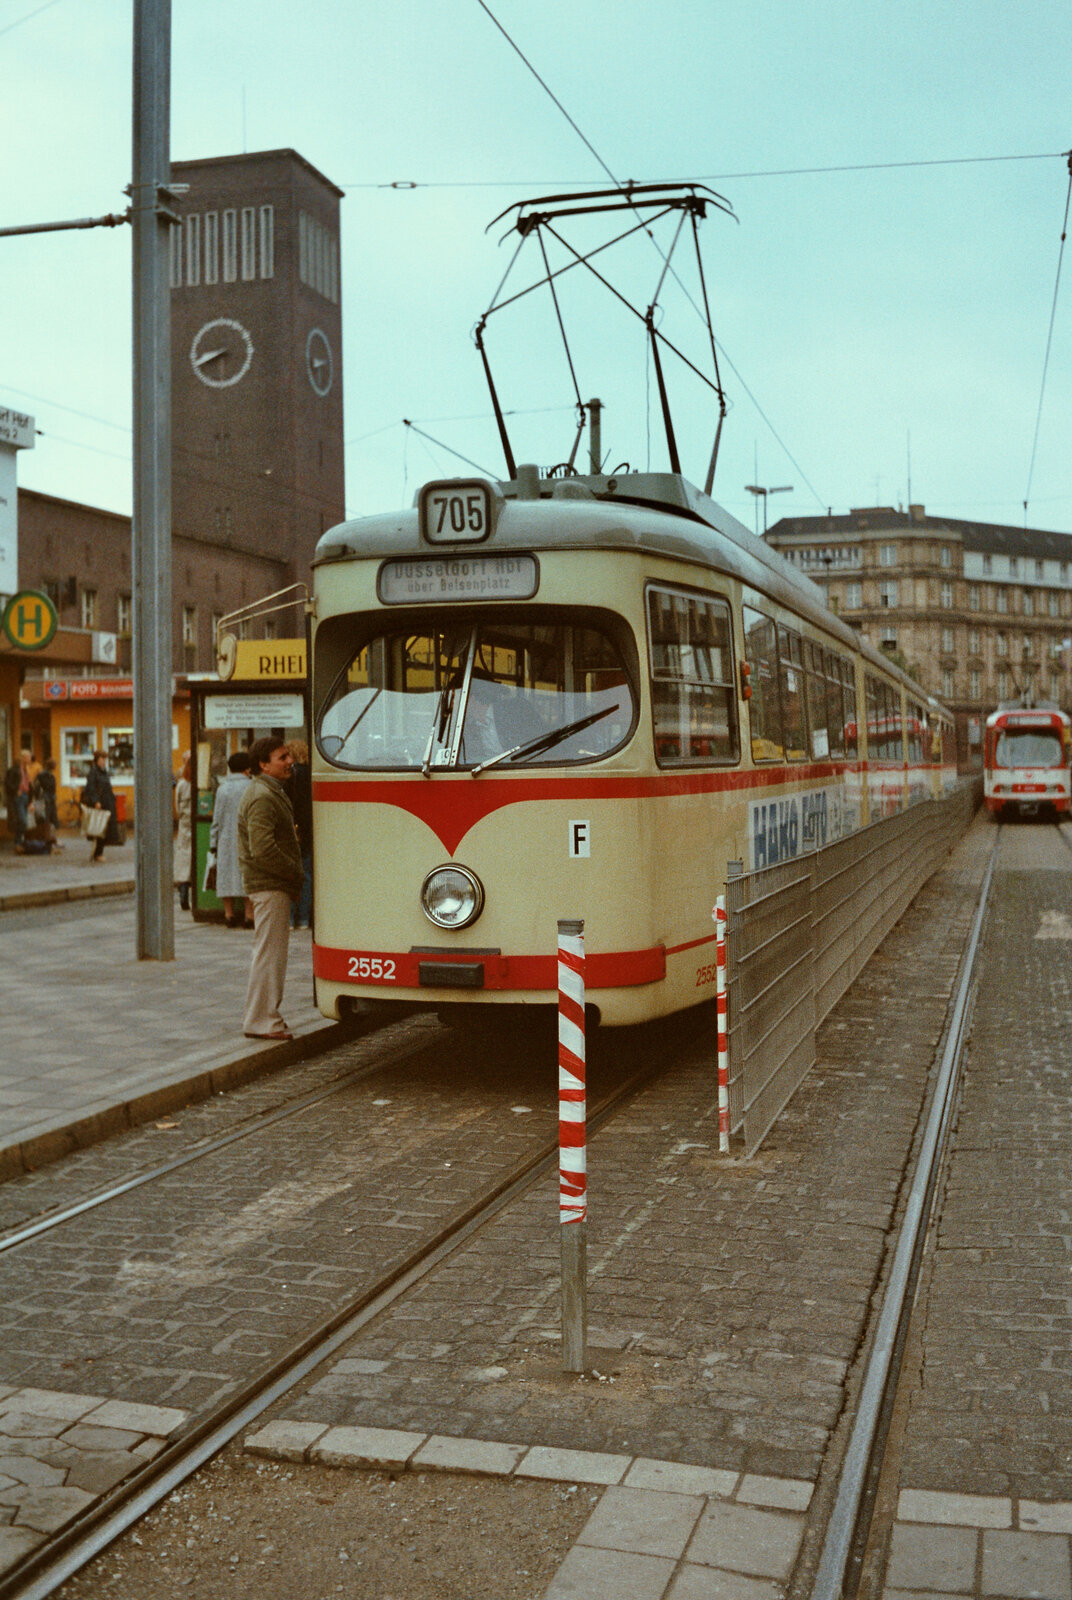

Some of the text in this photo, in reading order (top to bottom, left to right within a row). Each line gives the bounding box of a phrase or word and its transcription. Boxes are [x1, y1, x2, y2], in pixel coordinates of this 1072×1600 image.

[433, 495, 484, 533] 705
[407, 576, 511, 593] über Belsenplatz
[17, 604, 42, 638] H
[259, 655, 303, 674] RHEI
[573, 824, 587, 855] F
[347, 957, 397, 981] 2552
[695, 963, 717, 987] 2552
